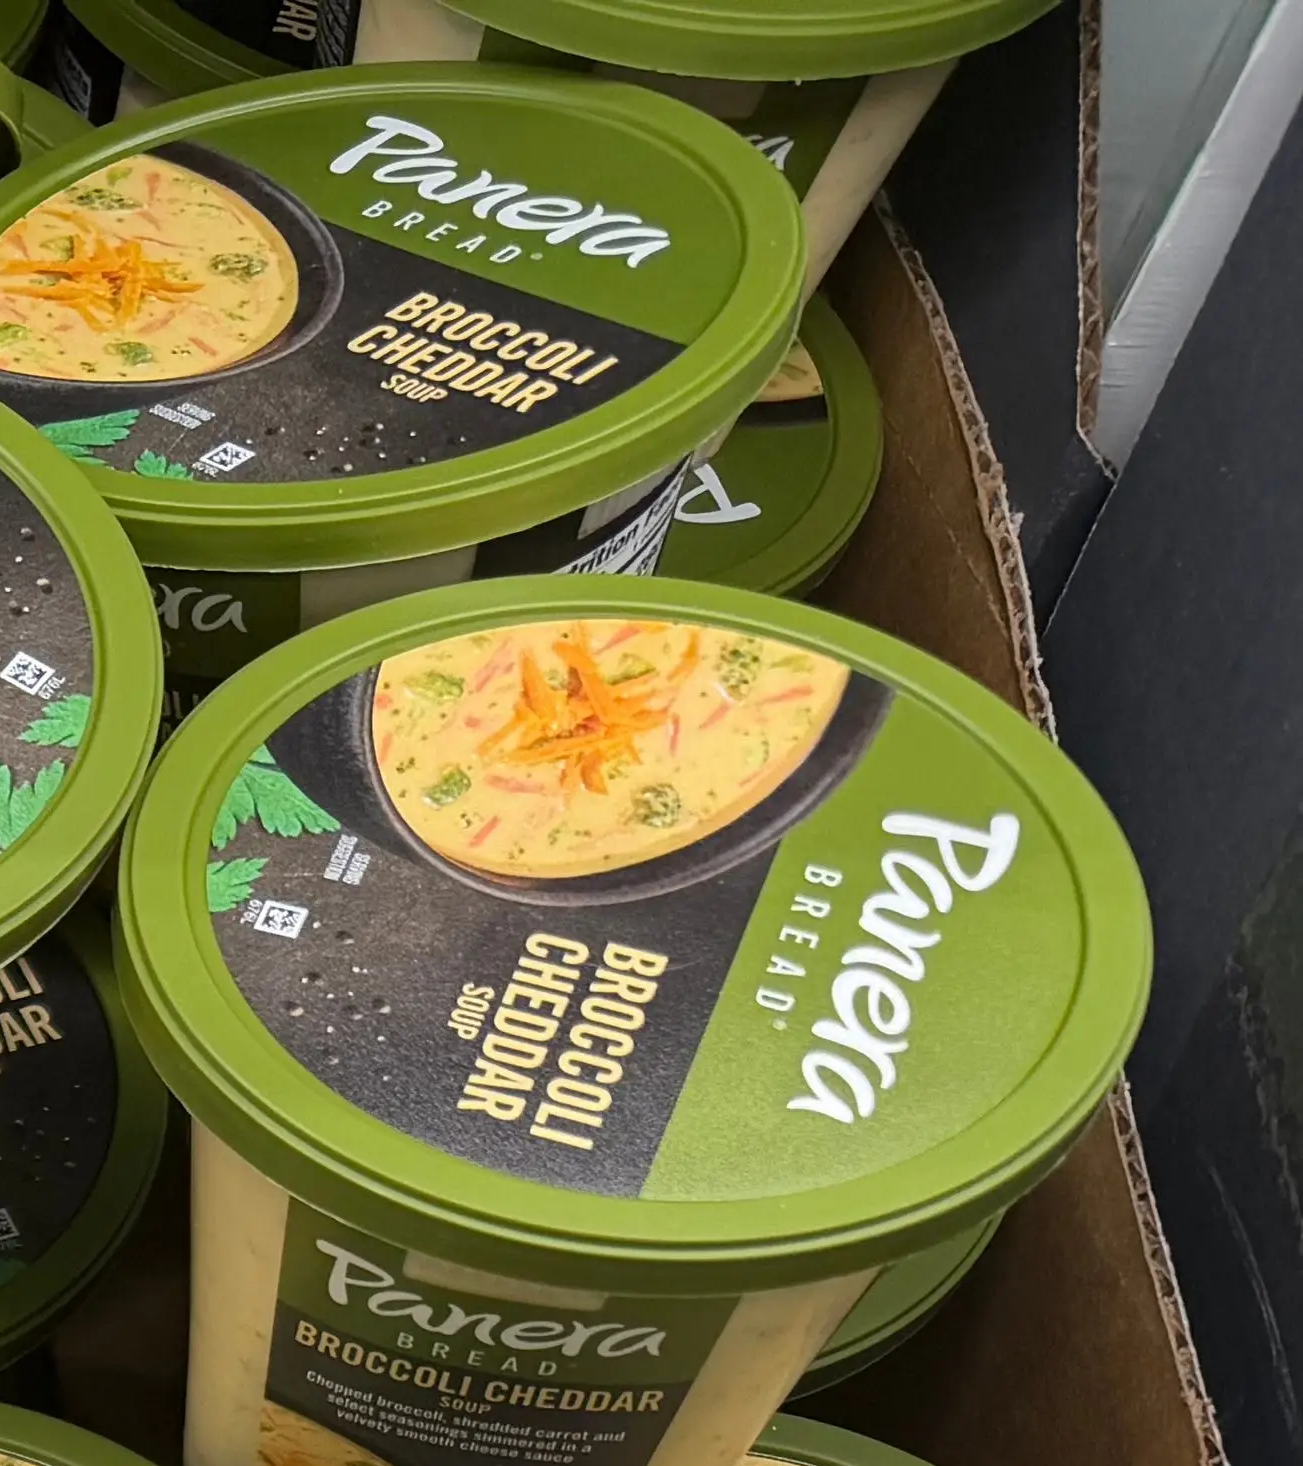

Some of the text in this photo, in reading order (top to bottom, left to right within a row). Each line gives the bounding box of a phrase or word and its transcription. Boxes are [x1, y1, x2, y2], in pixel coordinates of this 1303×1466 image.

[328, 115, 671, 269] Panera
[346, 323, 560, 415] CHEDDAR
[386, 292, 618, 389] BROCCOLI
[379, 373, 446, 404] SOUP
[38, 675, 67, 700] 676L
[786, 810, 1020, 1124] Panera
[446, 981, 479, 1040] SOUP
[456, 932, 590, 1124] CHEDDAR
[529, 942, 668, 1152] BROCCOLI
[316, 1239, 666, 1358] Panera
[294, 1320, 665, 1412] BROCCOLI CHEDDAR
[396, 1332, 557, 1376] BREAD
[306, 1370, 372, 1402] Chopped
[453, 1414, 531, 1437] shredded
[536, 1425, 589, 1441] carrot
[593, 1431, 626, 1442] and
[327, 1392, 592, 1453] select seasonings simmered in a
[336, 1408, 575, 1464] velvety smooth cheese sauce
[439, 1396, 492, 1415] SOUP
